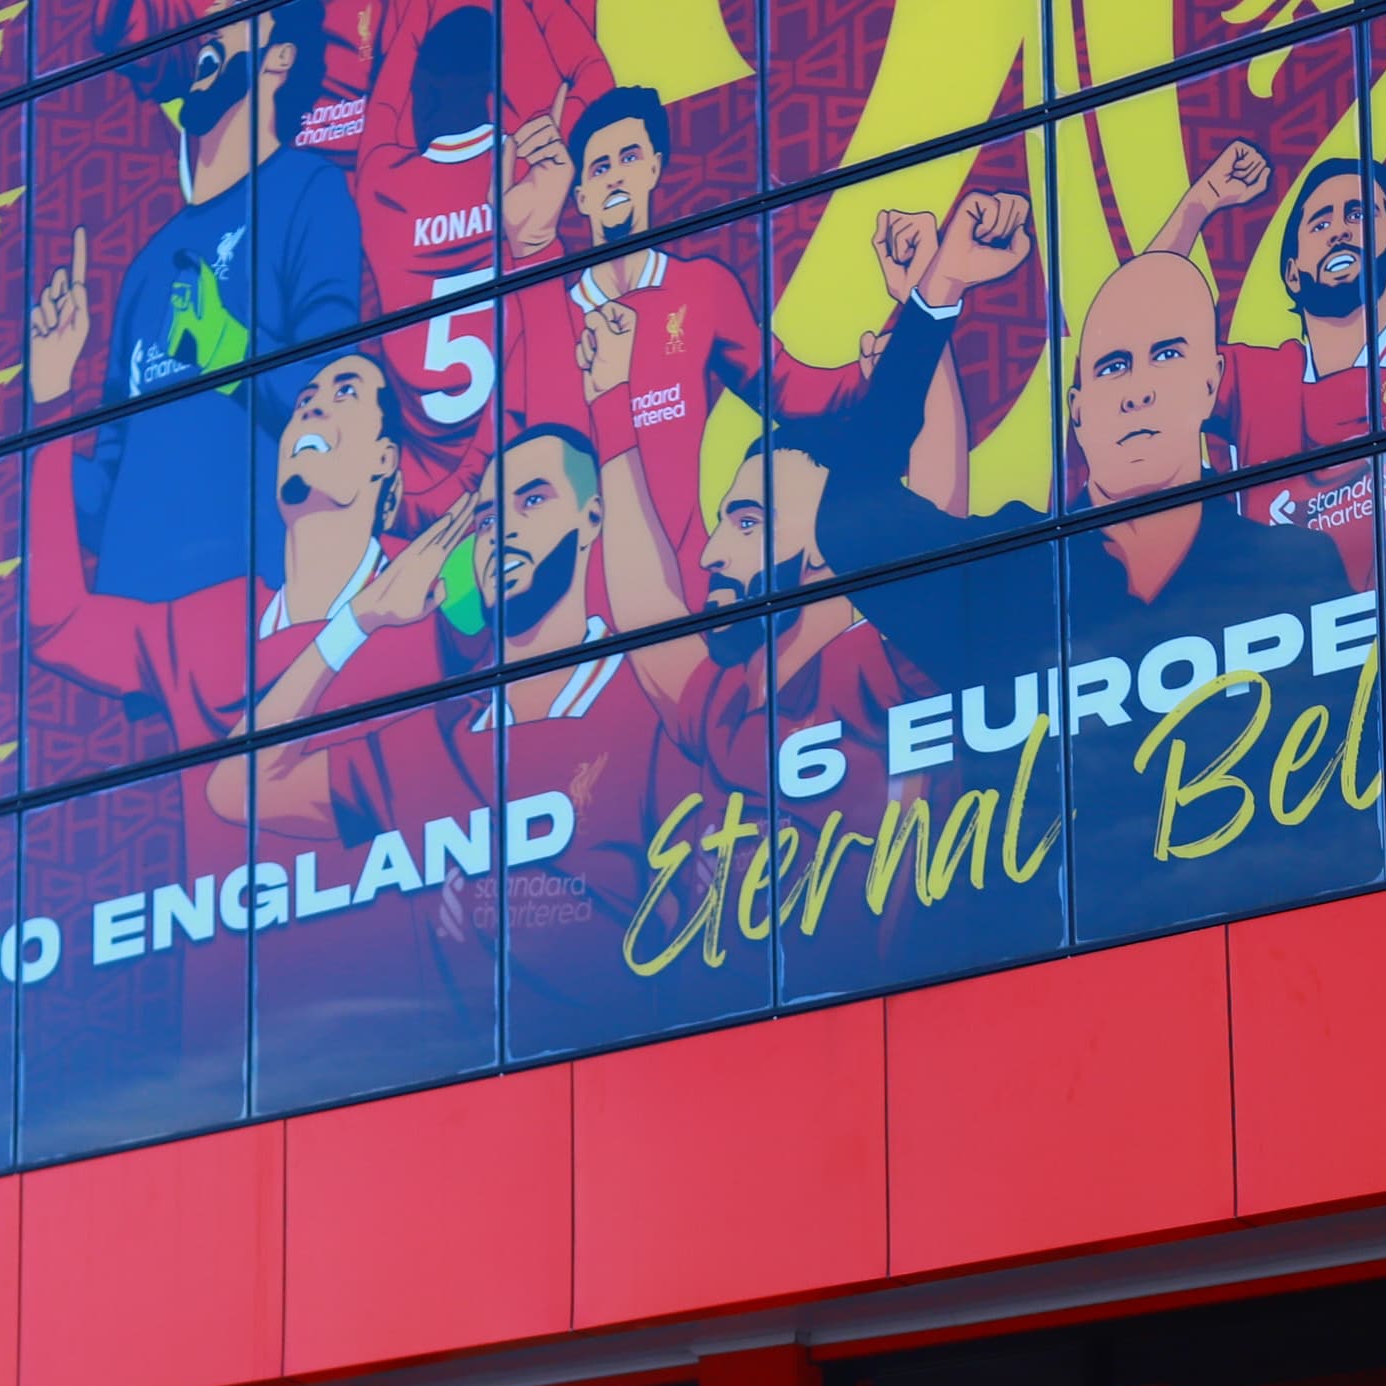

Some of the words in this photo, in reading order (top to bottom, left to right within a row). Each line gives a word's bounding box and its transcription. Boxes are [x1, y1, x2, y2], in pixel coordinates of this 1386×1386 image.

[294, 116, 366, 147] chartered
[413, 203, 493, 247] KONAT
[420, 267, 499, 424] 5
[631, 382, 681, 411] ndard
[776, 719, 847, 799] 6
[92, 790, 575, 966] ENGLAND
[620, 712, 1077, 977] Eternal
